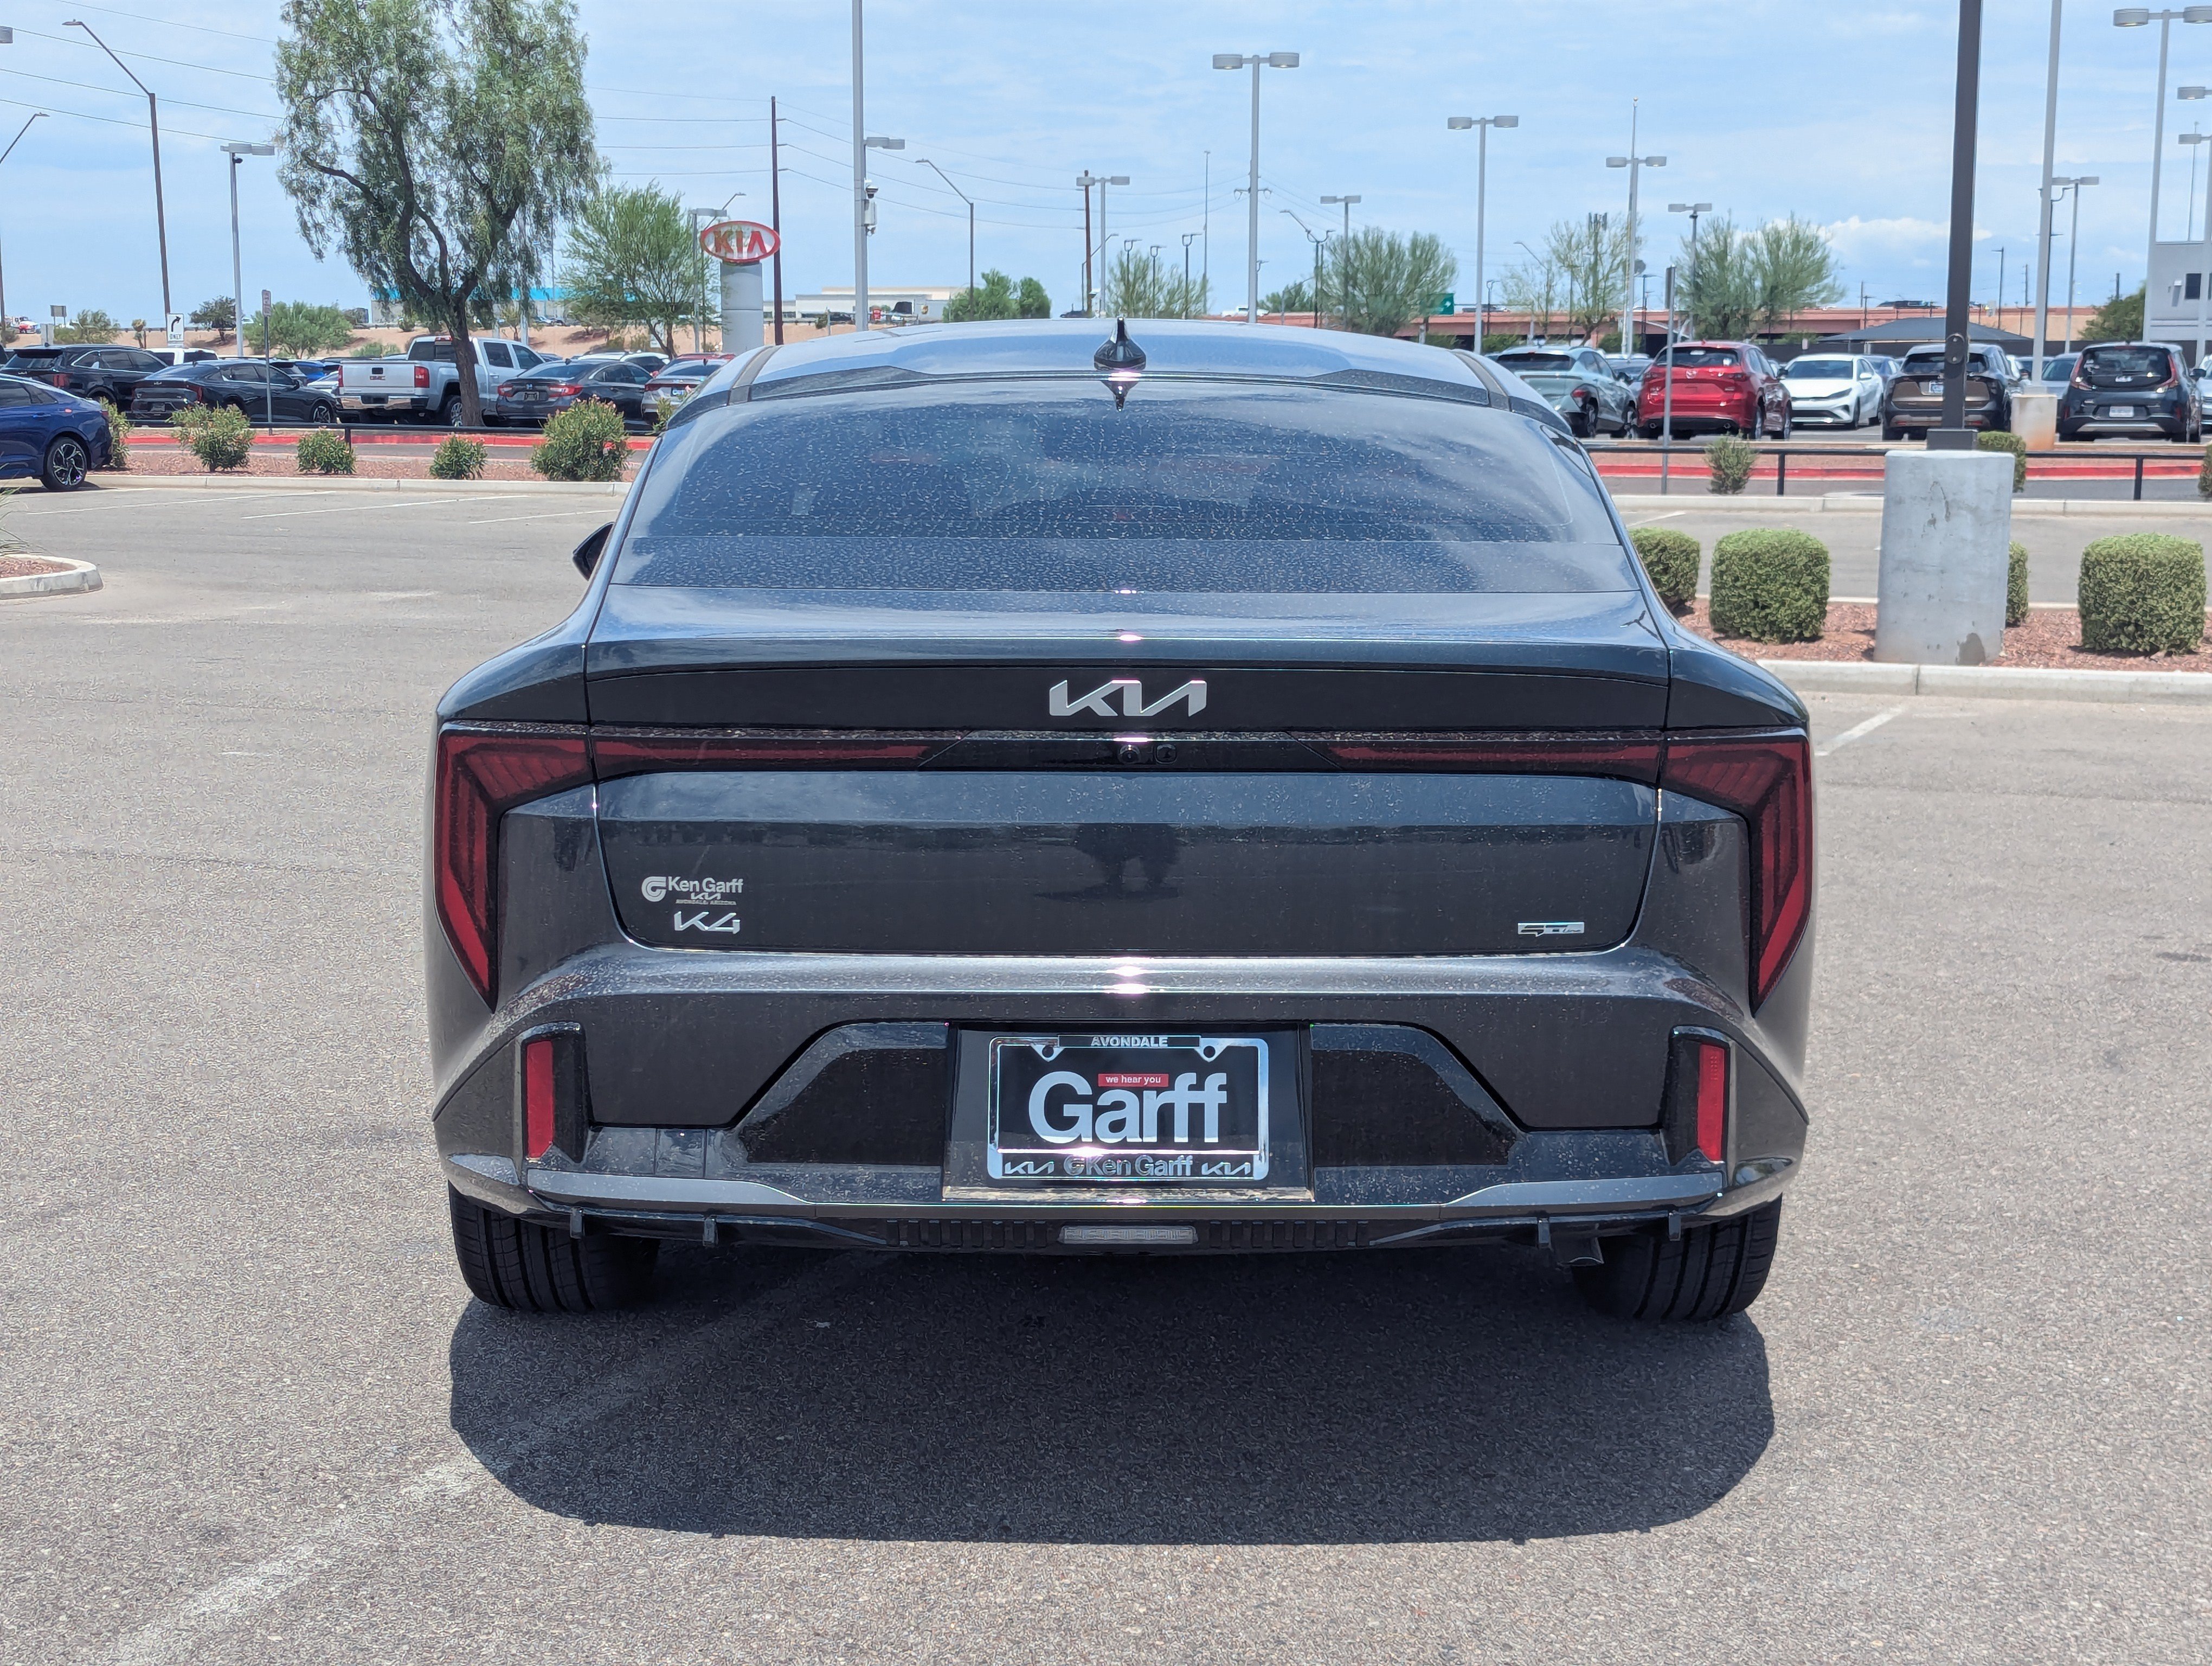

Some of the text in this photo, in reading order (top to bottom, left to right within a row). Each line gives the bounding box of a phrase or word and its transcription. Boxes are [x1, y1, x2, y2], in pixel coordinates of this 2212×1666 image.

[713, 230, 767, 253] KIA
[1049, 680, 1207, 717] KIA
[668, 876, 699, 892] Ken
[702, 877, 743, 893] Garff
[674, 911, 741, 934] K4
[1090, 1035, 1168, 1048] AVONDALE
[1121, 1074, 1142, 1083] hear
[1144, 1077, 1161, 1085] you
[1028, 1071, 1227, 1144] Garff
[1086, 1155, 1131, 1176] Ken
[1135, 1155, 1193, 1176] Garff
